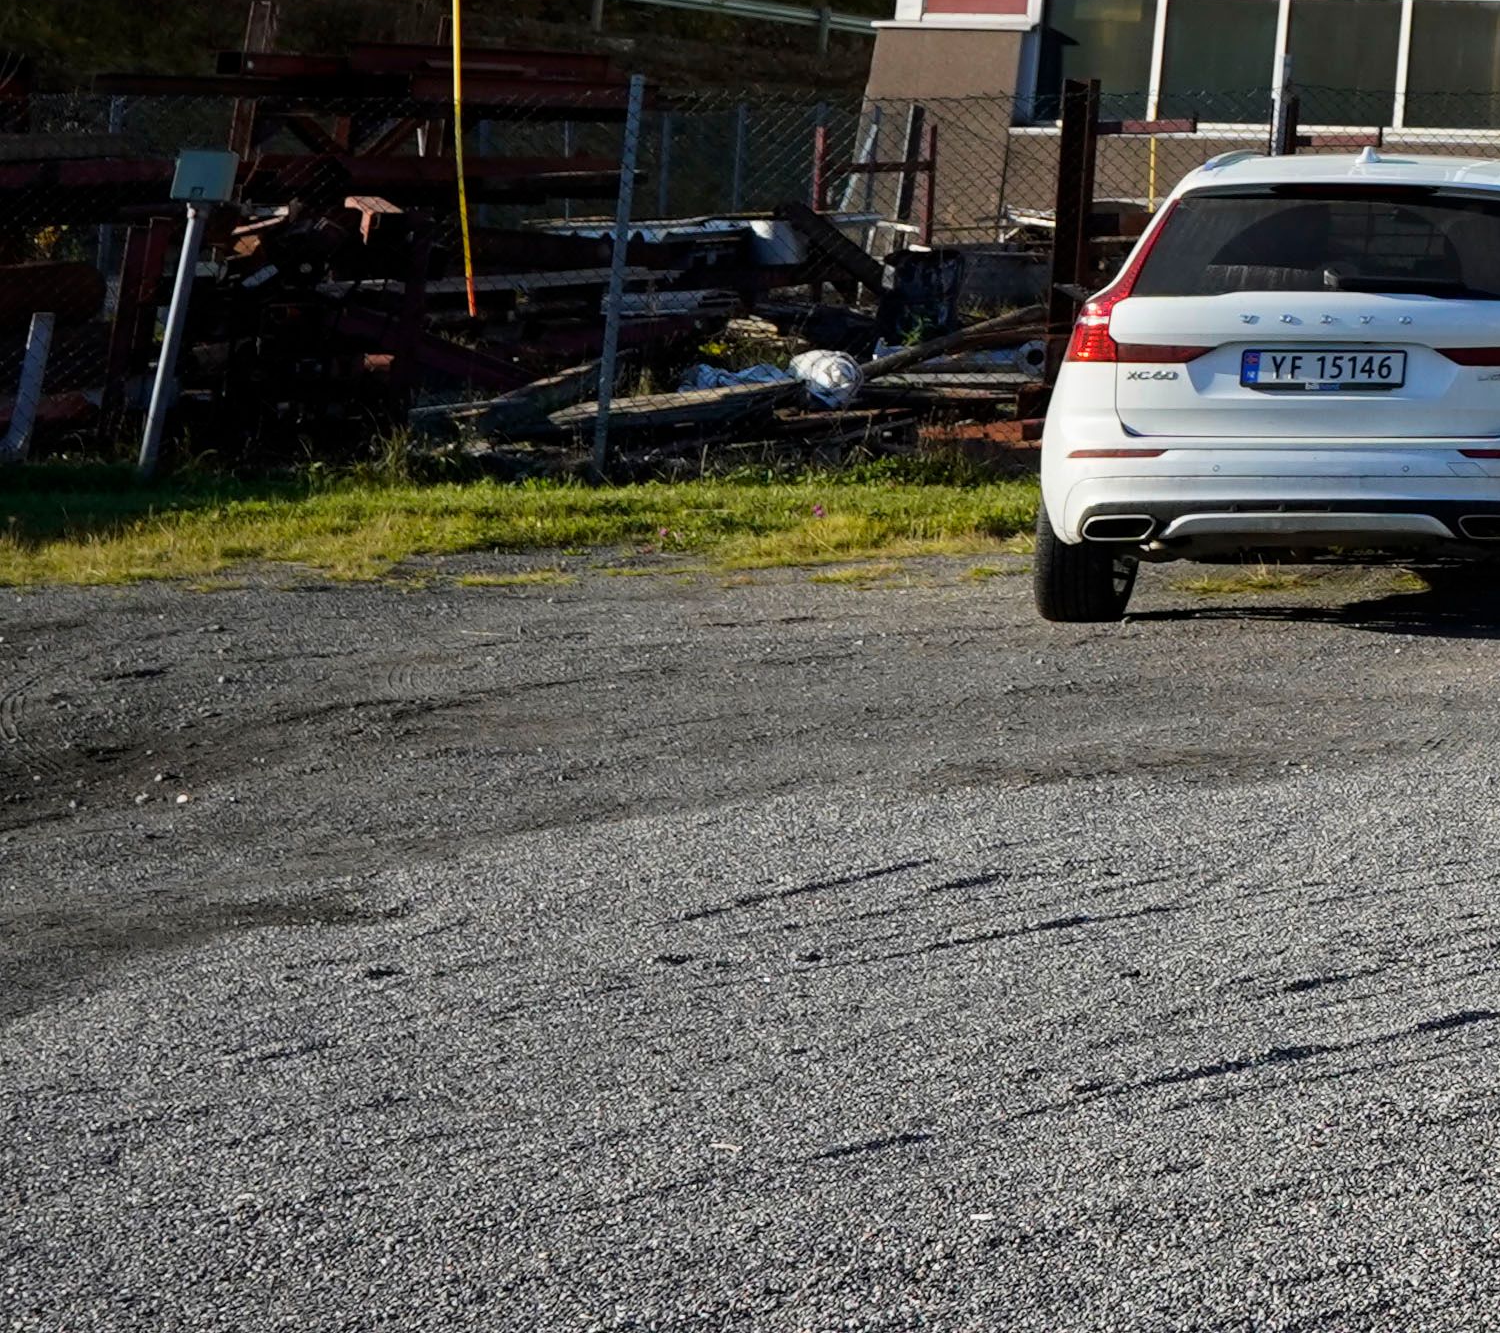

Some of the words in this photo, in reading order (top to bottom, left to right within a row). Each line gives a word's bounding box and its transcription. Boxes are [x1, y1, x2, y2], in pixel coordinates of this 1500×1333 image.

[1271, 355, 1303, 379] YF
[1316, 355, 1393, 379] 15146
[1127, 371, 1179, 381] XC60
